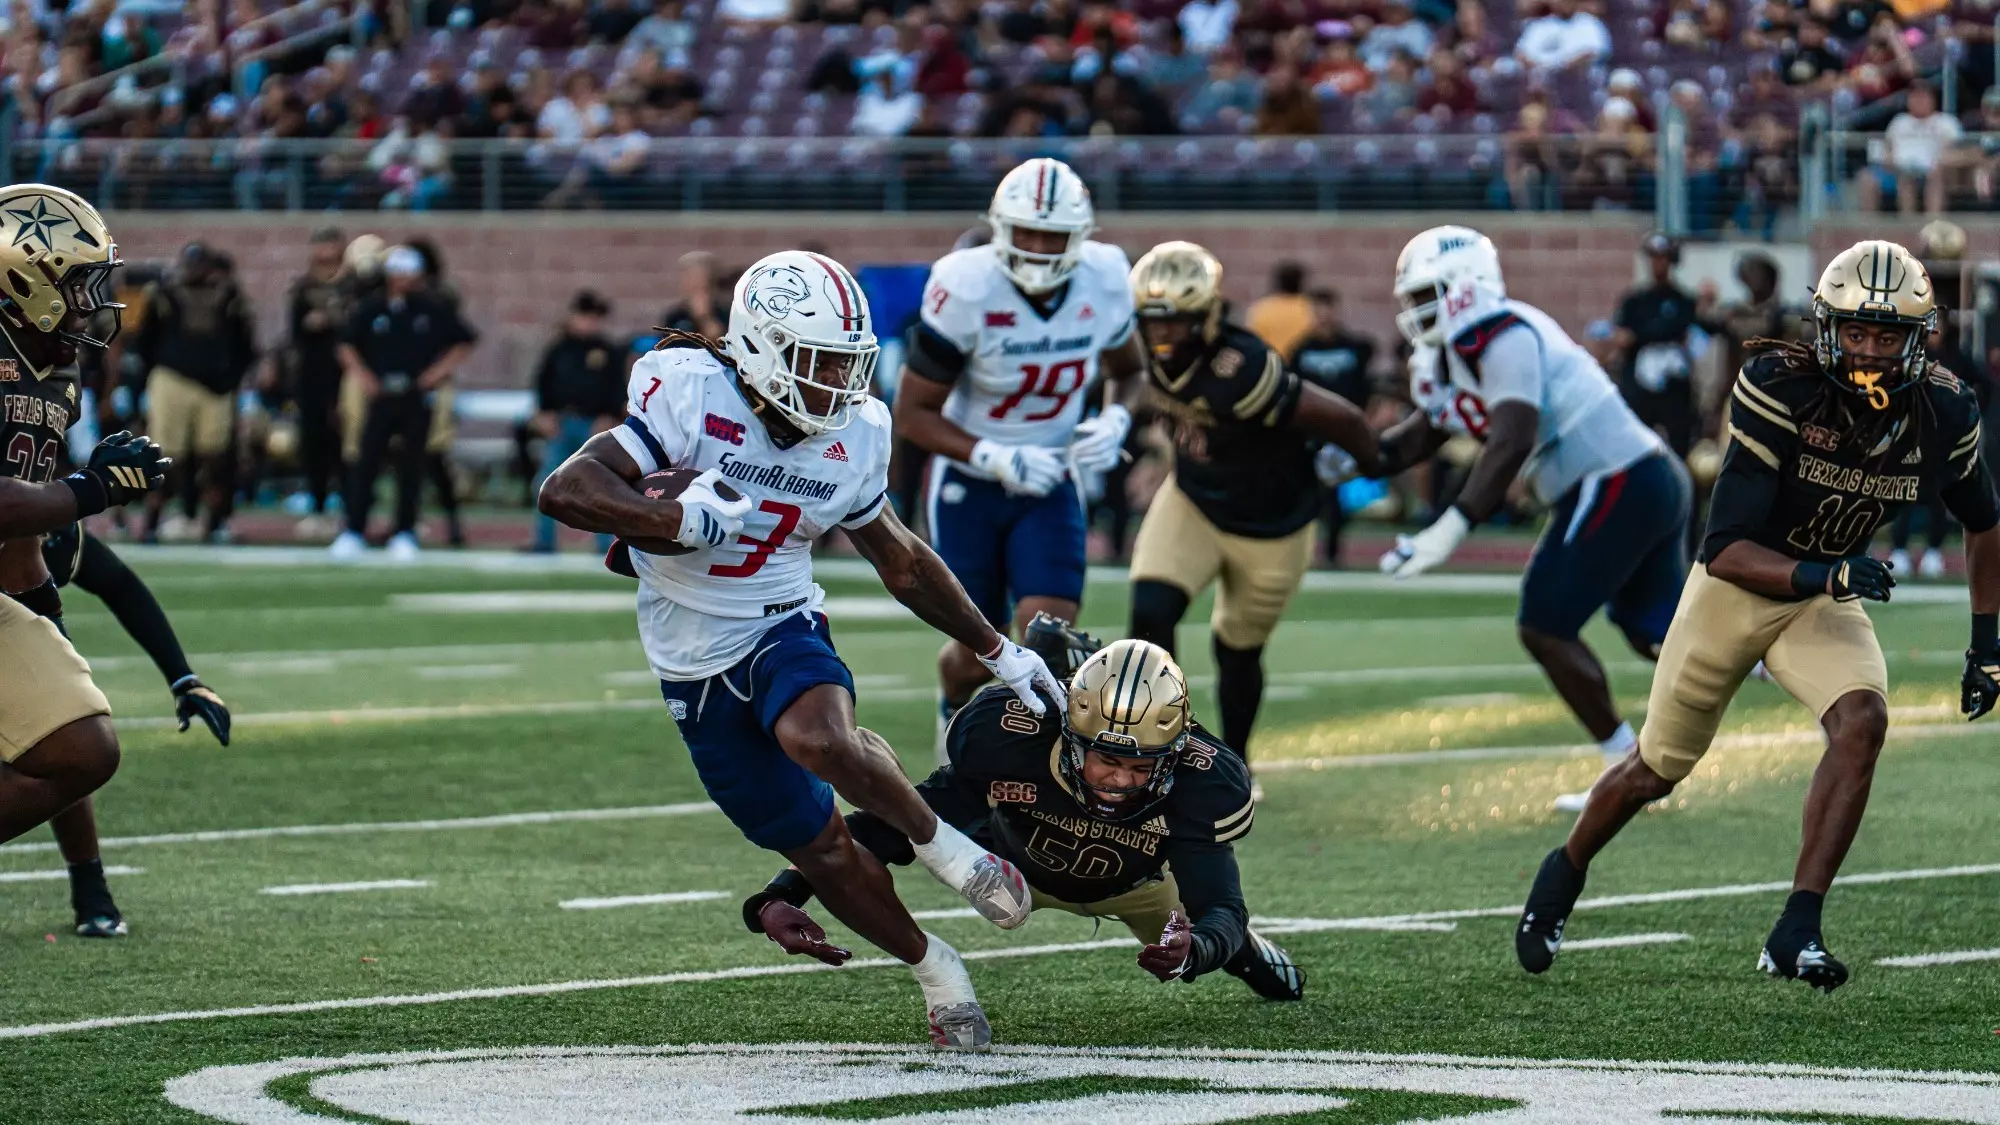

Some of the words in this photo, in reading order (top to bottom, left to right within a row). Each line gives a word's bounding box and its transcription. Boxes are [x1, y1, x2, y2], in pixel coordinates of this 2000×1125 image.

[4, 394, 43, 426] TEXAS
[822, 451, 849, 463] adidas
[1798, 453, 1863, 493] TEXAS
[1861, 474, 1920, 501] STATE
[708, 500, 802, 578] 3
[1786, 494, 1885, 556] 10
[1102, 733, 1133, 747] BOBCATS
[990, 780, 1038, 804] SBC
[1019, 807, 1089, 838] XAS
[1090, 819, 1162, 857] STATE
[1140, 823, 1171, 837] adidas
[1025, 825, 1124, 880] 50
